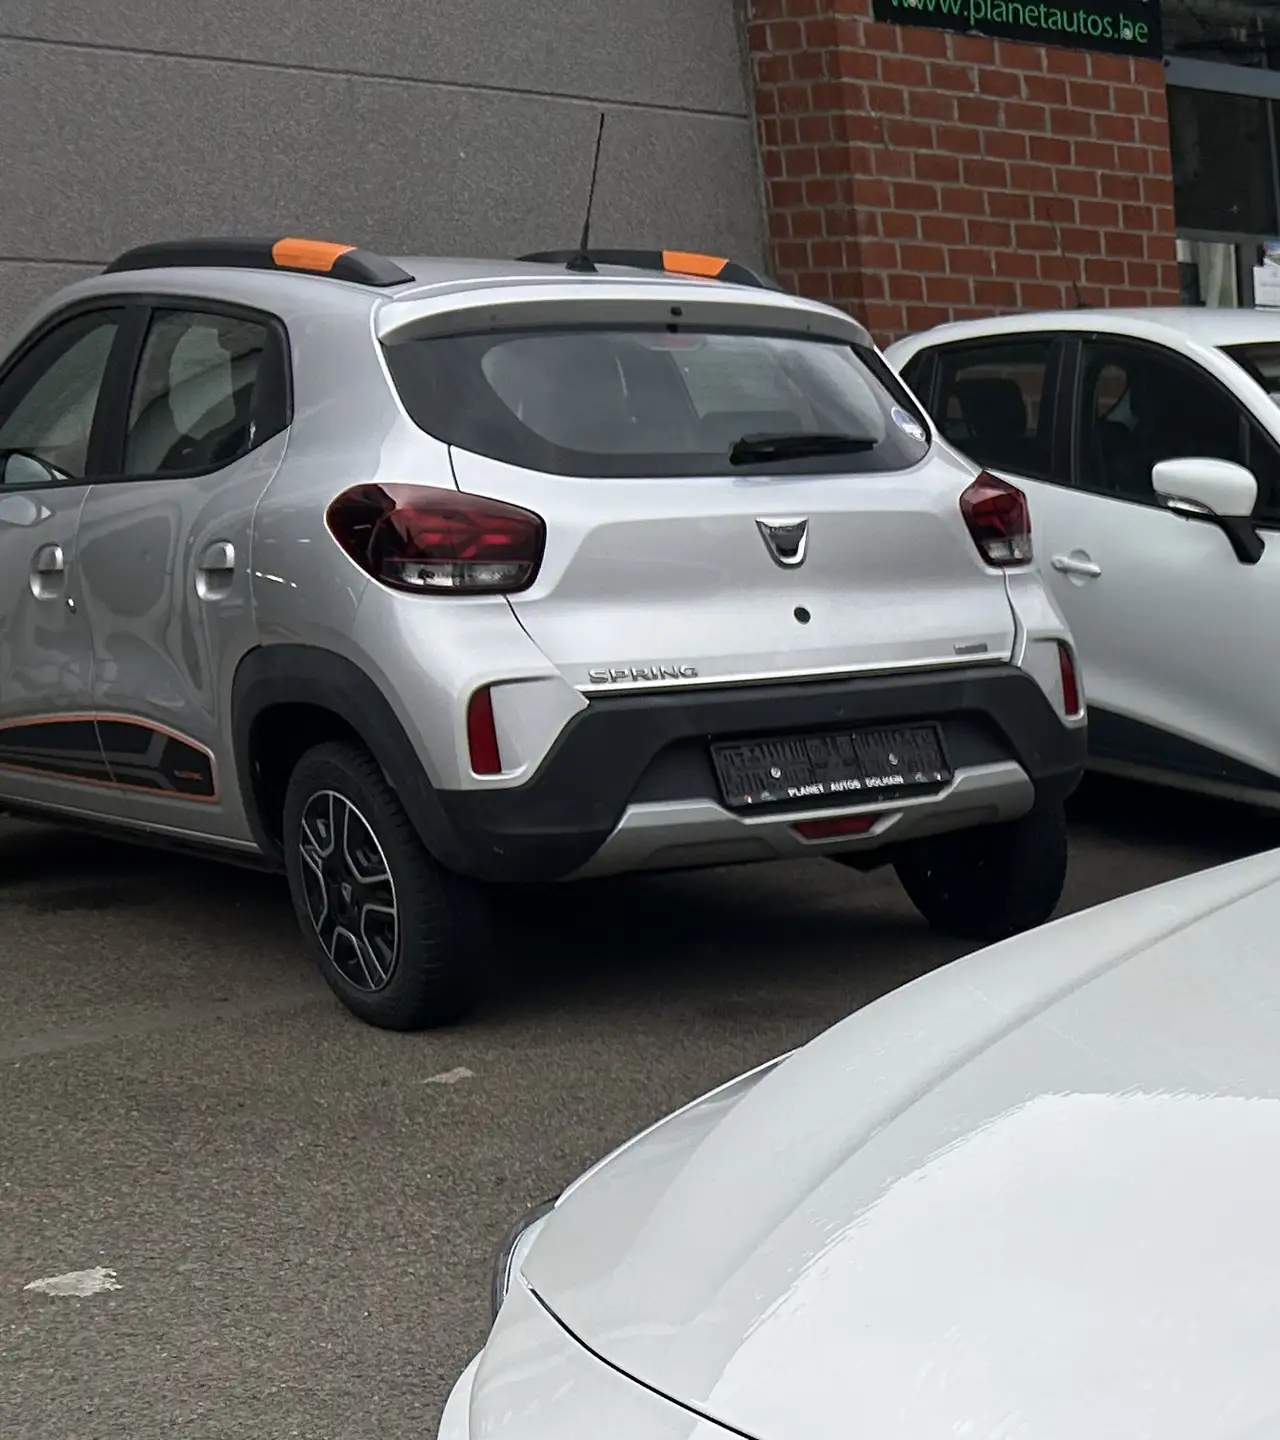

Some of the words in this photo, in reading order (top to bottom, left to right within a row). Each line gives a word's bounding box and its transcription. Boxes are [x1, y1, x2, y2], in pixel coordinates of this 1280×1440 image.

[588, 665, 699, 684] SPRING
[787, 783, 825, 798] PLANET
[830, 778, 861, 792] AUTOS
